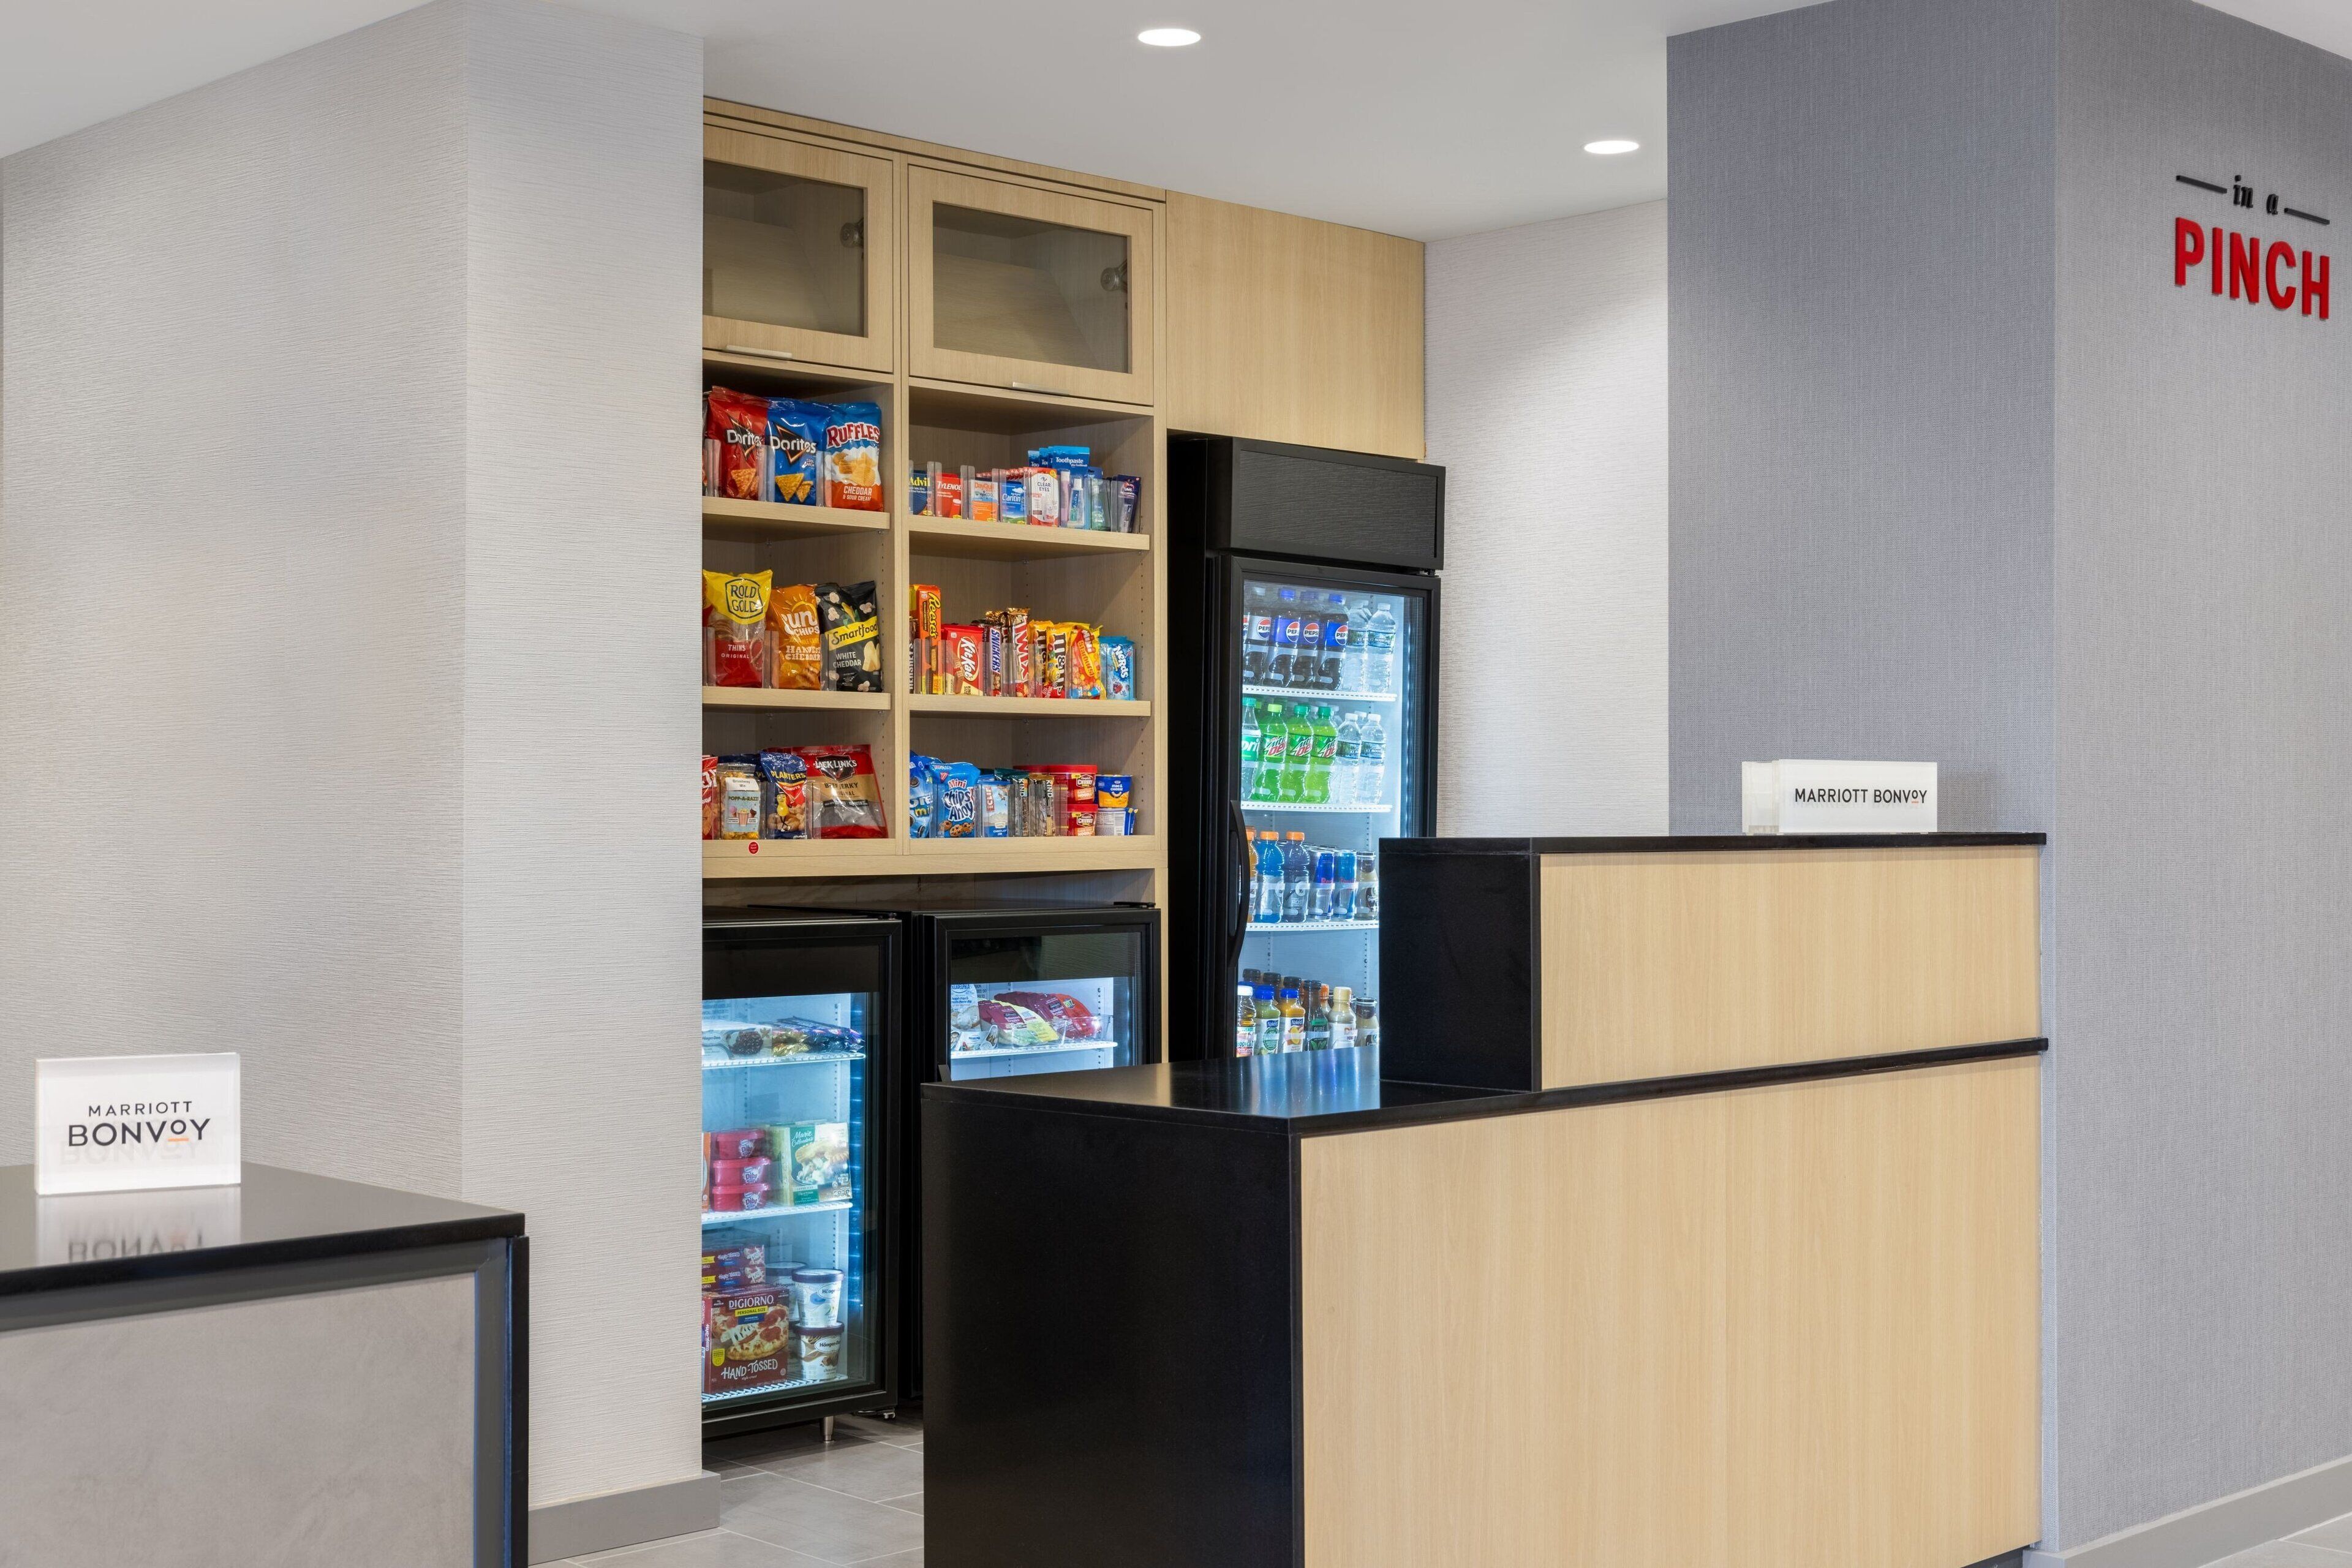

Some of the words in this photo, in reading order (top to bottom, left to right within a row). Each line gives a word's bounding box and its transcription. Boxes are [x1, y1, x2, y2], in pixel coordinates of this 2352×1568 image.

[2233, 175, 2253, 209] in
[2266, 194, 2279, 215] a
[2175, 217, 2330, 320] PINCH
[726, 429, 762, 448] Doritos
[827, 422, 880, 448] RUFFLES
[770, 435, 817, 454] Doritos
[1056, 457, 1084, 466] Toothpaste
[909, 477, 931, 487] Advil
[937, 481, 962, 491] TYLENOL
[843, 486, 872, 496] CHEDDAR
[730, 584, 757, 599] ROLD
[731, 599, 758, 613] GOLD
[927, 592, 941, 639] Reese's
[793, 625, 820, 636] CHIPS
[831, 624, 878, 645] Smartfood
[835, 651, 857, 660] WHITE
[991, 628, 1000, 673] SNICKERS
[832, 659, 862, 668] CHEDDAR
[813, 760, 834, 769] JACK
[834, 760, 858, 768] LINK'S
[771, 770, 807, 781] PLANTERS
[1795, 788, 1868, 804] MARRIOTT
[1874, 789, 1928, 804] BONVOY
[88, 1101, 192, 1117] MARRIOTT
[68, 1118, 211, 1147] BONVOY
[792, 1130, 812, 1140] Marie
[721, 1359, 778, 1379] HAND-TOSSED
